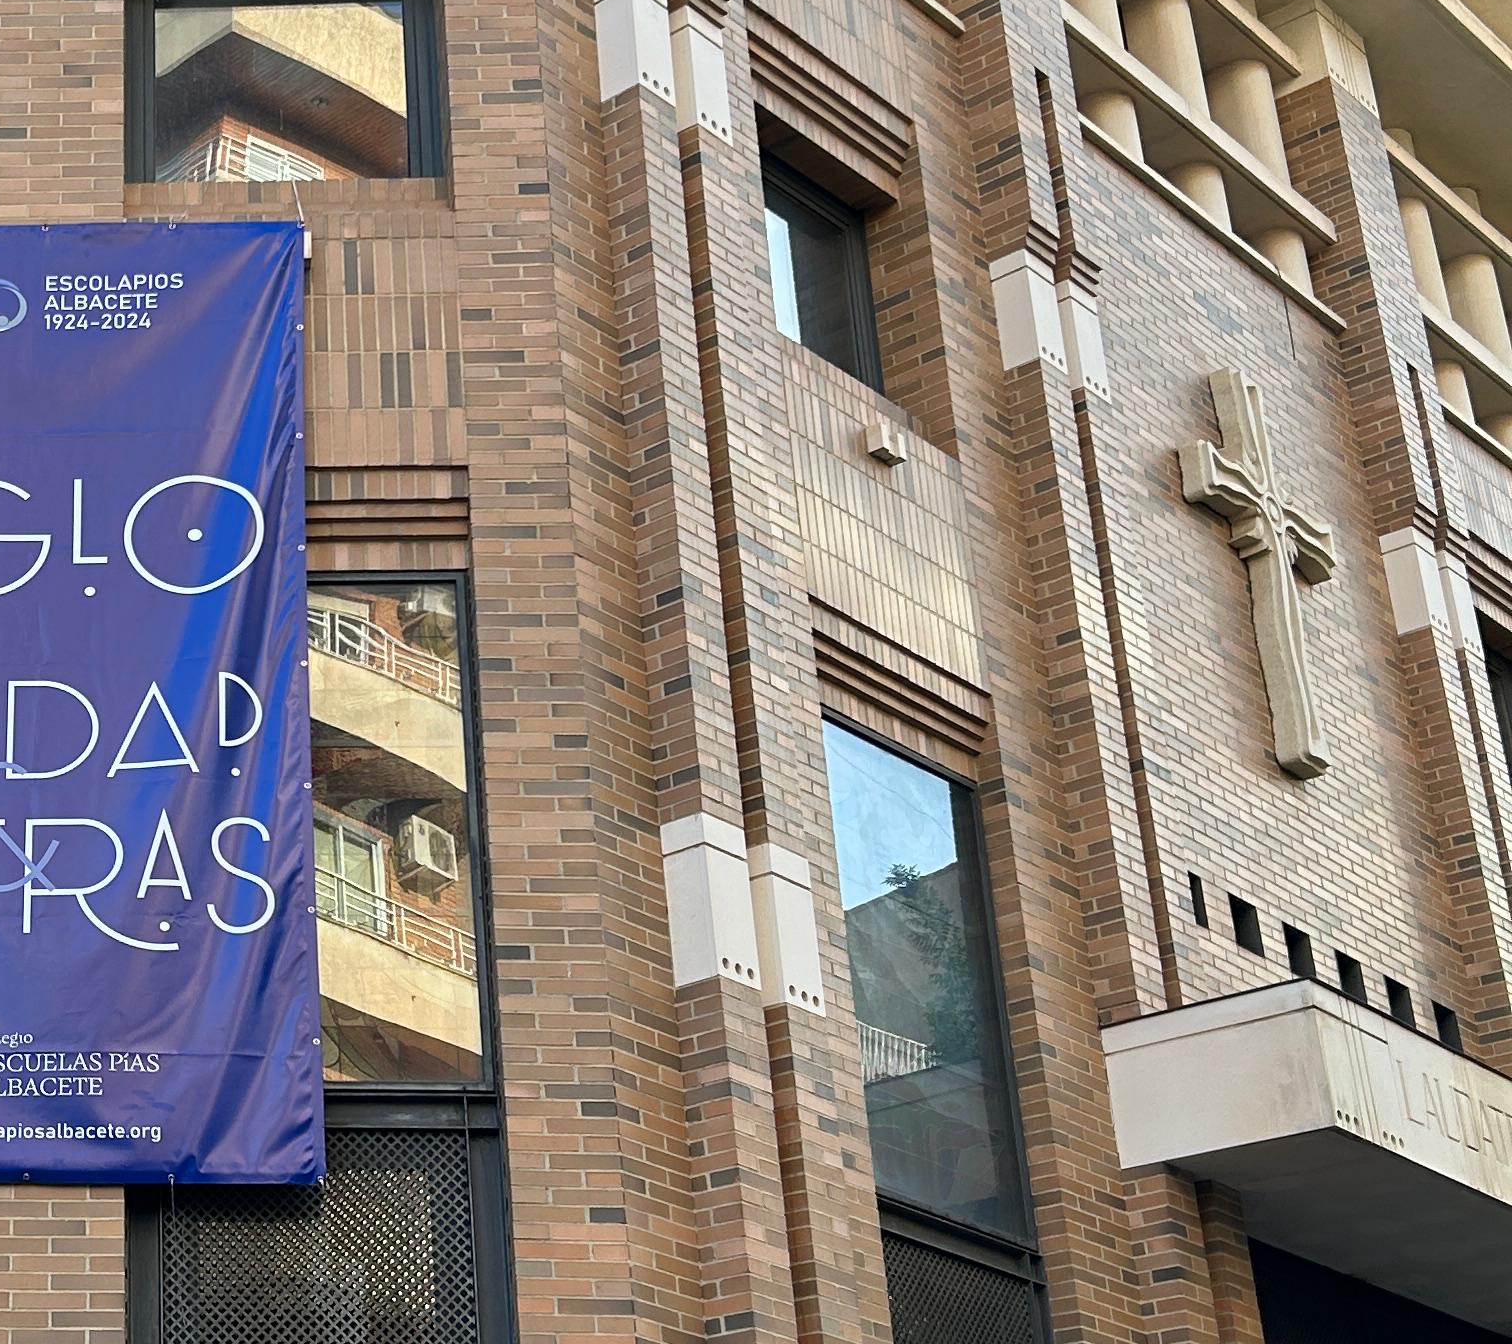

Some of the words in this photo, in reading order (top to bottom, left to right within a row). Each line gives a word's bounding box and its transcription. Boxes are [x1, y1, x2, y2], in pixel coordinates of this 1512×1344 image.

[44, 273, 185, 292] ESCOLAPIOS
[43, 293, 159, 311] ALBACETE
[43, 313, 152, 330] 1924-2024
